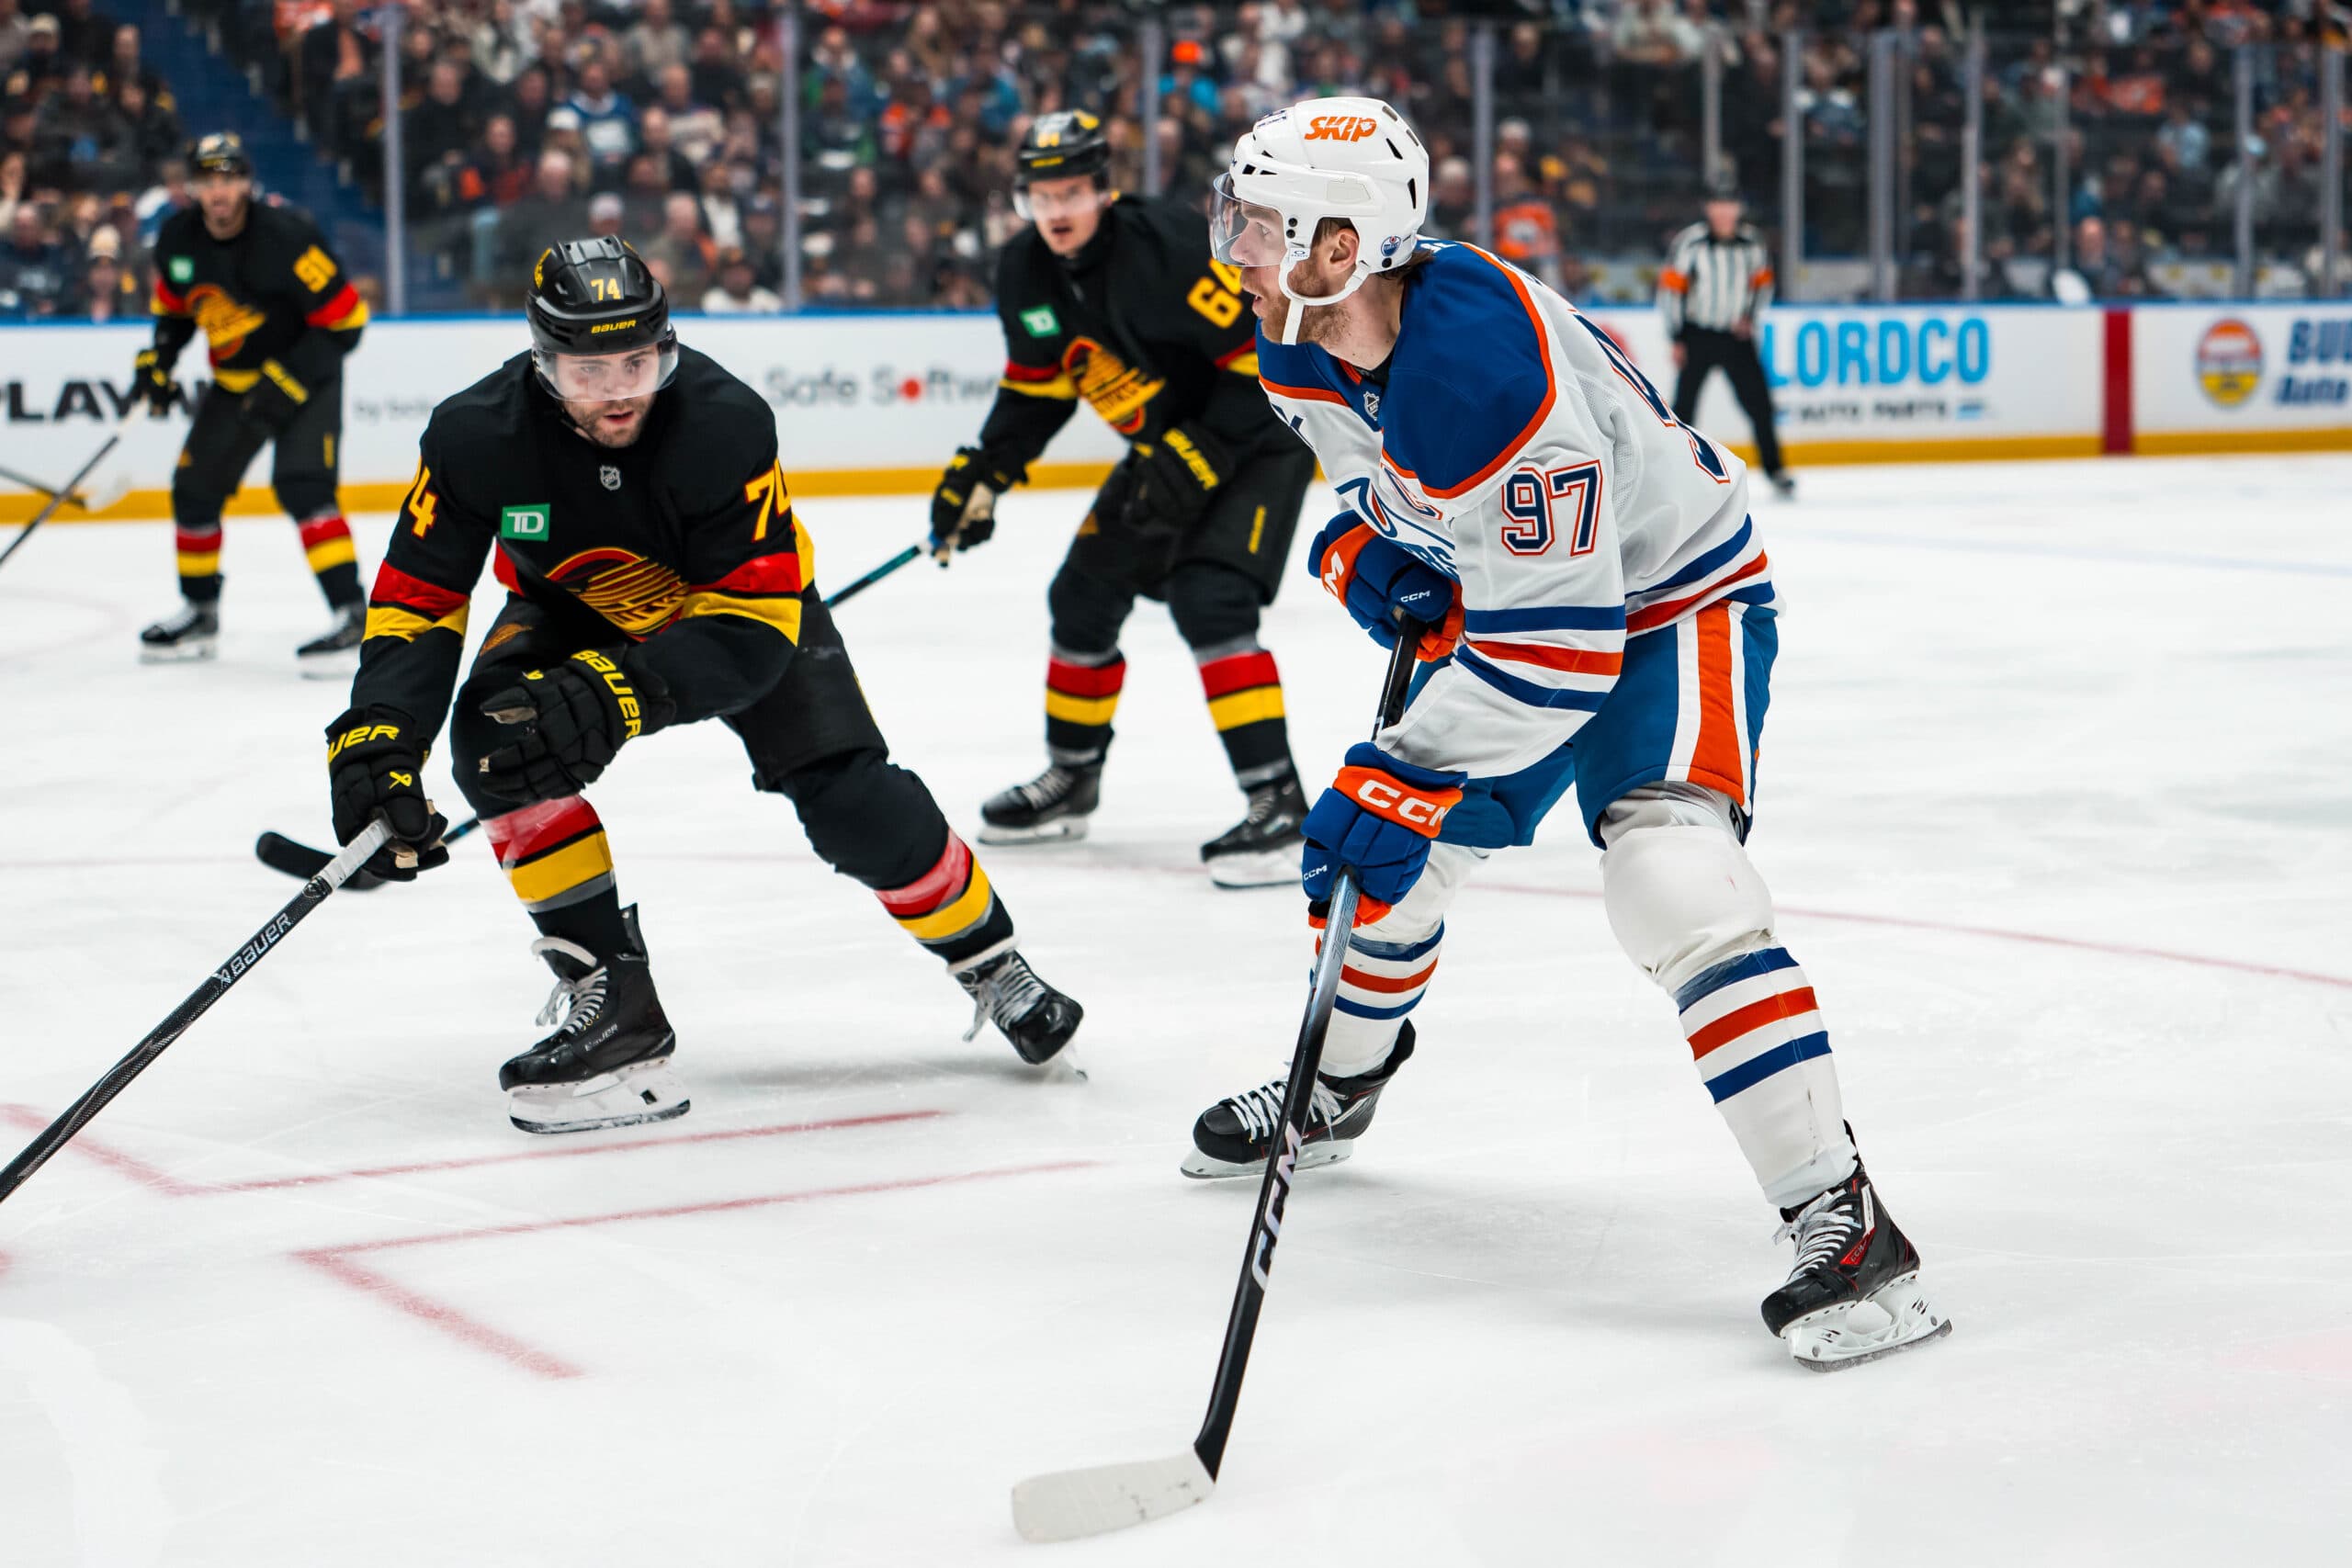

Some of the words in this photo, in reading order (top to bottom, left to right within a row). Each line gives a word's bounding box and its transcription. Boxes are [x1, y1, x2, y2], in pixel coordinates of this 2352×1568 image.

[1304, 116, 1377, 142] SKIP
[590, 278, 621, 301] 74
[591, 320, 637, 334] BAUER
[1761, 318, 1989, 389] LORDCO
[766, 367, 857, 405] Safe
[406, 456, 438, 540] 4
[1501, 459, 1603, 557] 97
[506, 512, 545, 534] TD
[1400, 590, 1430, 603] CCM
[571, 649, 641, 739] BAUER
[328, 725, 400, 763] UER
[1303, 864, 1328, 881] CCM
[230, 912, 293, 977] BAUER
[1251, 1121, 1303, 1292] CCM
